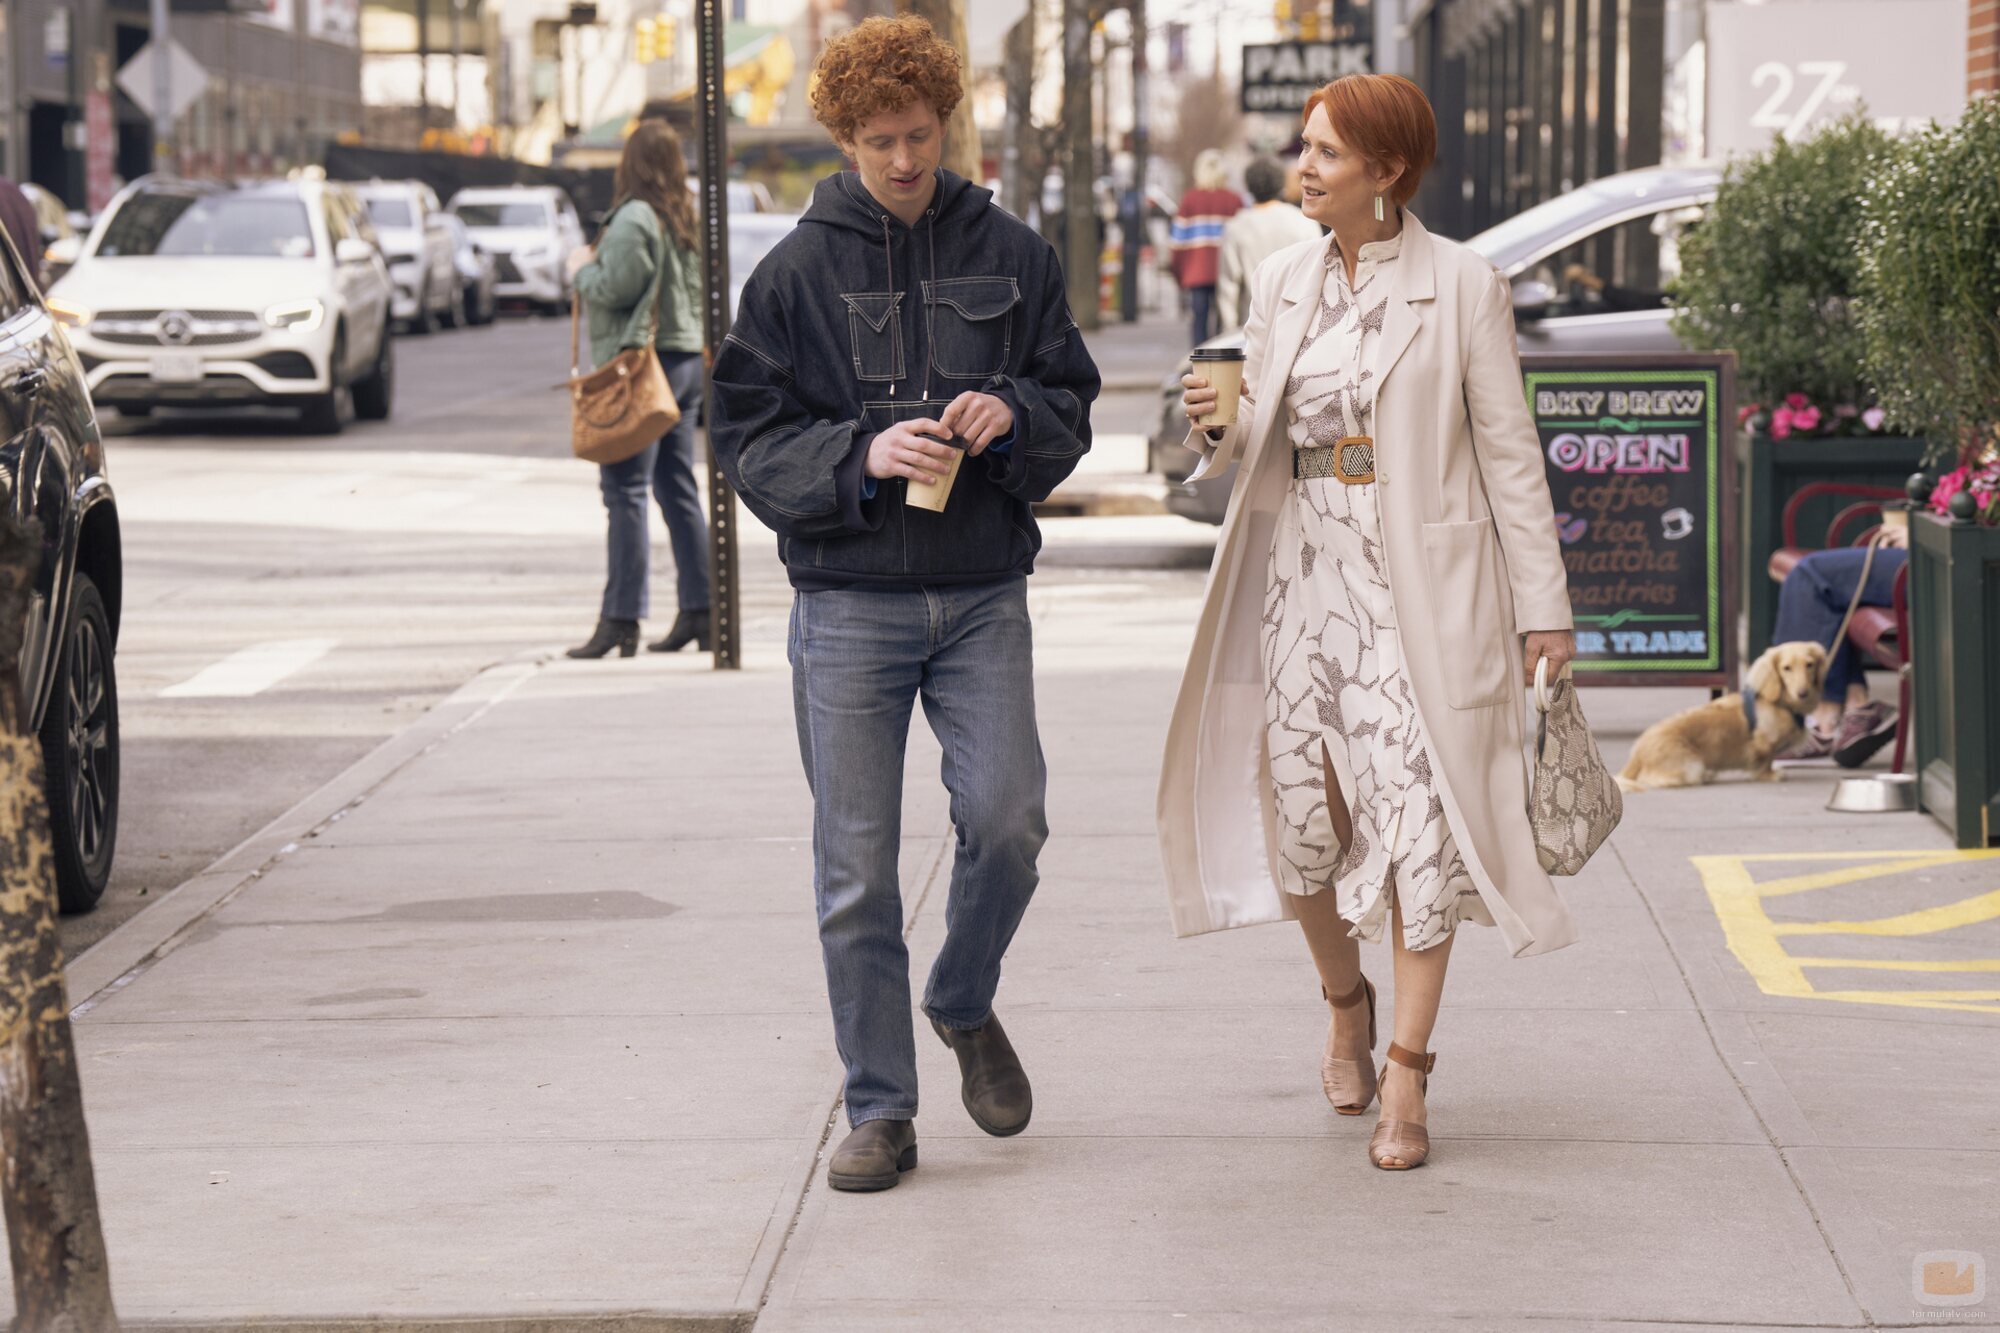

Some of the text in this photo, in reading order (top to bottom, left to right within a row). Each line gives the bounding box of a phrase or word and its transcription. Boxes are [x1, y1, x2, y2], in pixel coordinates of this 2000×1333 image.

[1246, 44, 1371, 82] PARK
[1750, 60, 1848, 142] 27
[1608, 390, 1704, 416] BREW
[1548, 432, 1690, 473] OPEN
[1569, 474, 1669, 512] coffee
[1591, 511, 1647, 543] tea
[1564, 542, 1679, 573] matcha
[1575, 630, 1706, 653] IR TRADE
